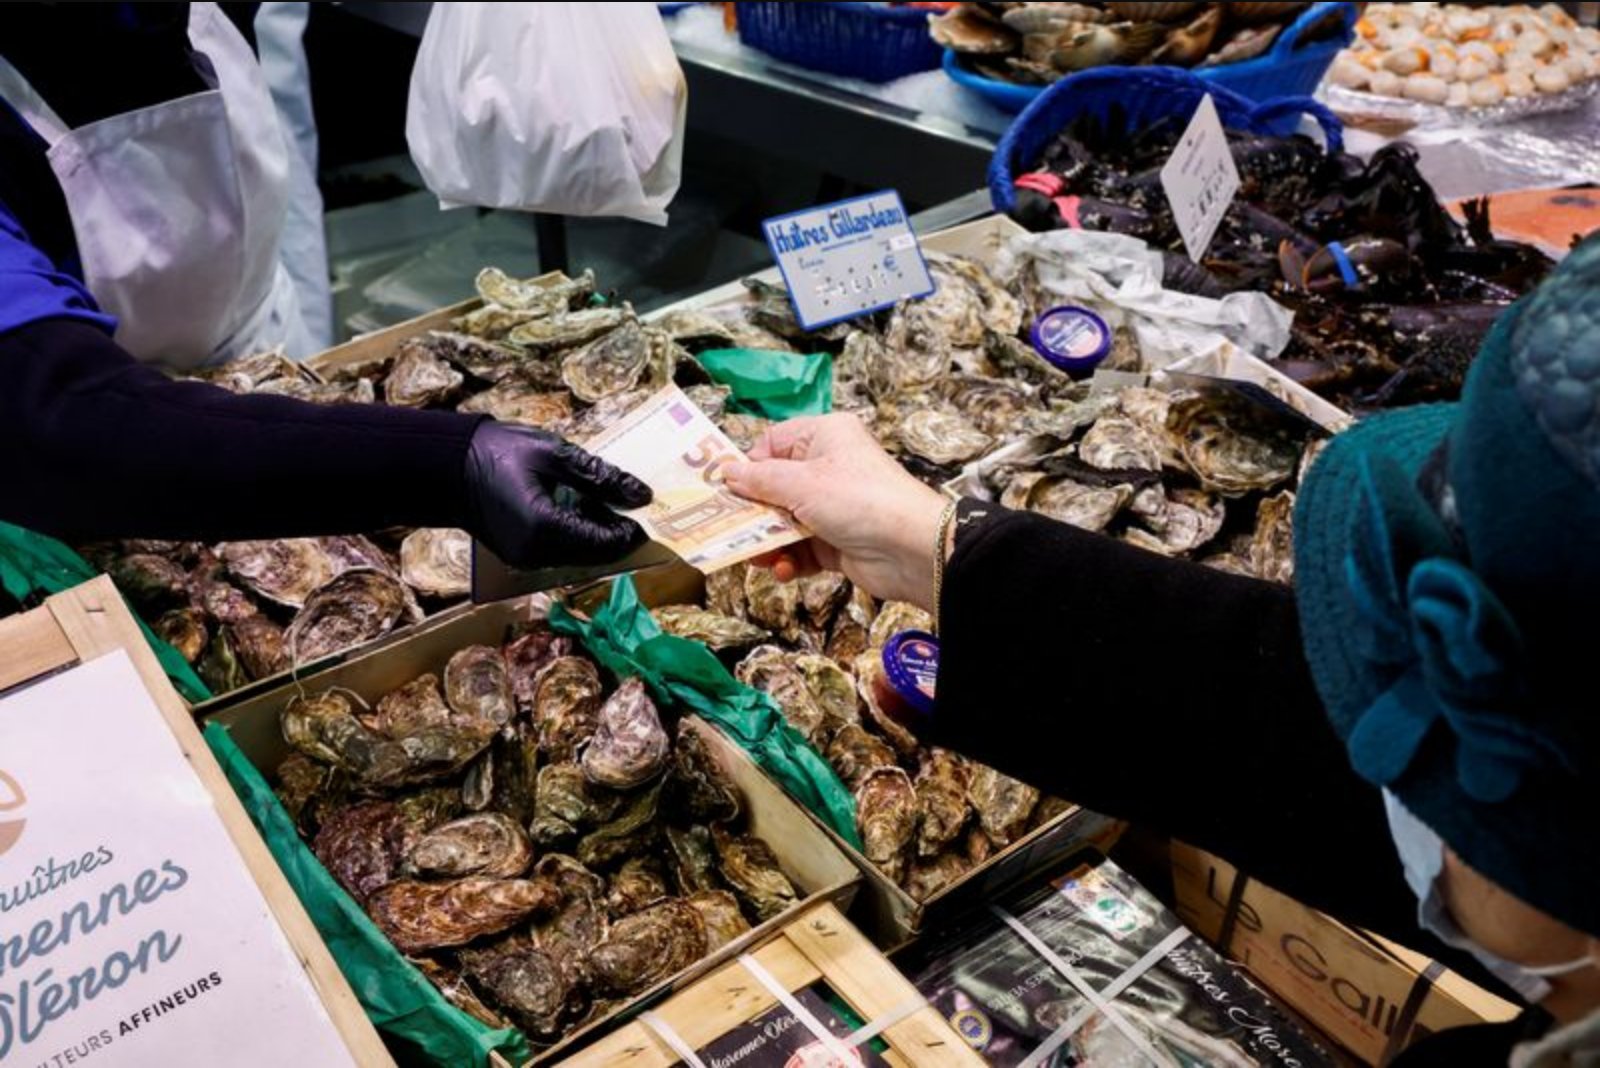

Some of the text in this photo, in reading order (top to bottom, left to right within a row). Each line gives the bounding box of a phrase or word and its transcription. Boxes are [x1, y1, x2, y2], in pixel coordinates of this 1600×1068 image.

[829, 202, 903, 239] Gillardeau
[37, 971, 222, 1068] TEURS AFFINEURS
